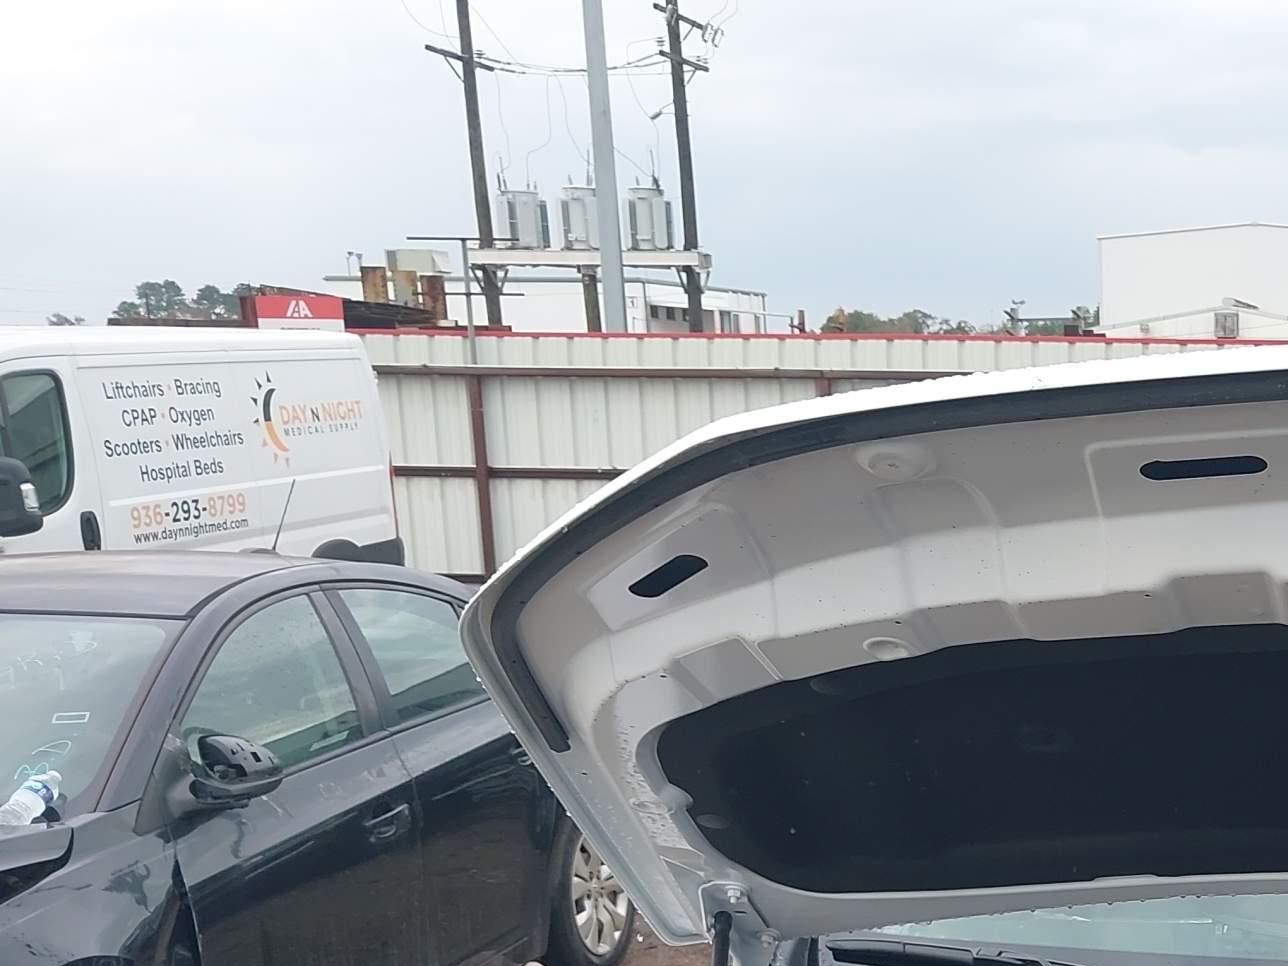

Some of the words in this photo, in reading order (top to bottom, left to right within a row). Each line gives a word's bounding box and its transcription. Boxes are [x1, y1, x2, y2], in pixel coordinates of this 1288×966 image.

[102, 381, 165, 399] Liftchairs
[174, 378, 221, 398] Bracing
[121, 408, 157, 427] CPAP
[168, 406, 215, 426] Oxygen
[279, 404, 308, 425] DAY
[310, 407, 320, 422] N
[320, 400, 362, 422] NIGHT
[283, 425, 325, 436] MEDICAL
[328, 422, 358, 432] SUPPLY
[103, 438, 162, 457] Scooters
[171, 430, 244, 451] Wheelchairs
[139, 461, 191, 483] Hospital
[193, 457, 224, 476] Beds
[130, 493, 246, 528] 936-293-8799
[133, 518, 249, 544] www.daynnightmed.com
